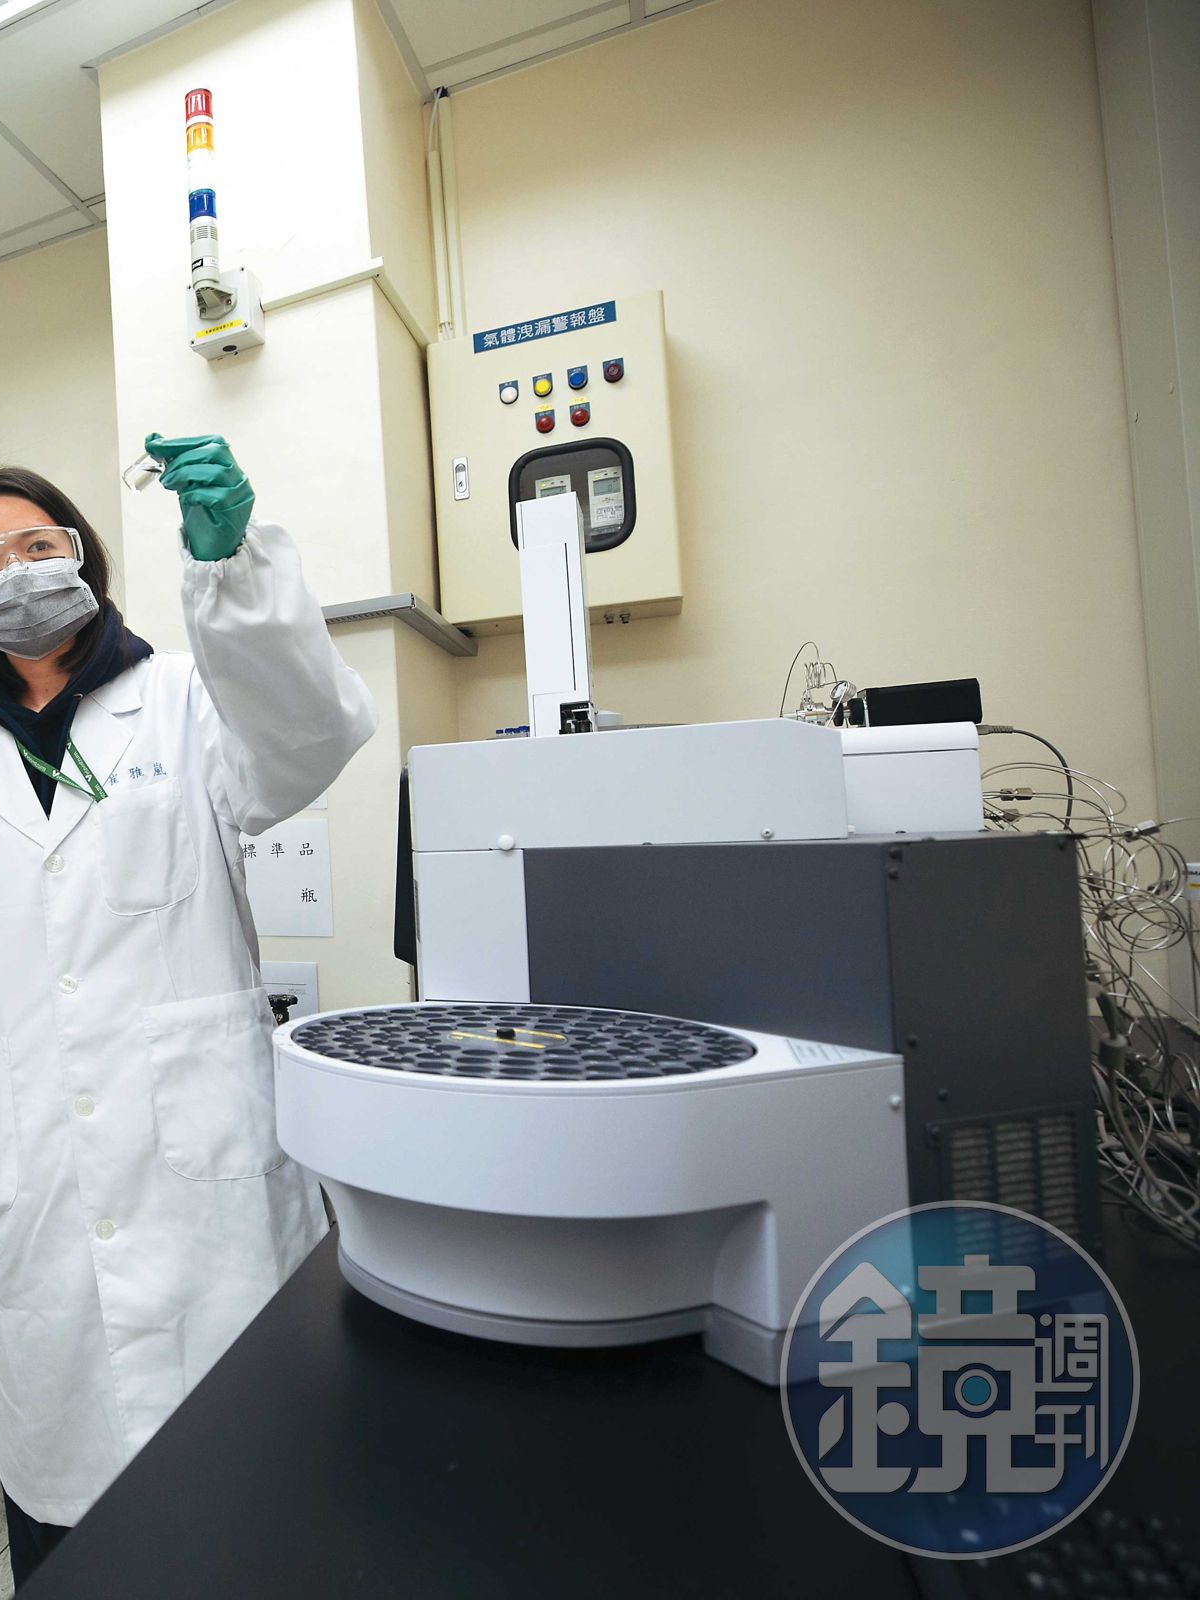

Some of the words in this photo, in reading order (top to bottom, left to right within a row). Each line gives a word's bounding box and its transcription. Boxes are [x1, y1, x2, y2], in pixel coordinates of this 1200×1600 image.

[484, 307, 606, 348] 氣體洩漏警報盤
[301, 887, 318, 903] 瓶
